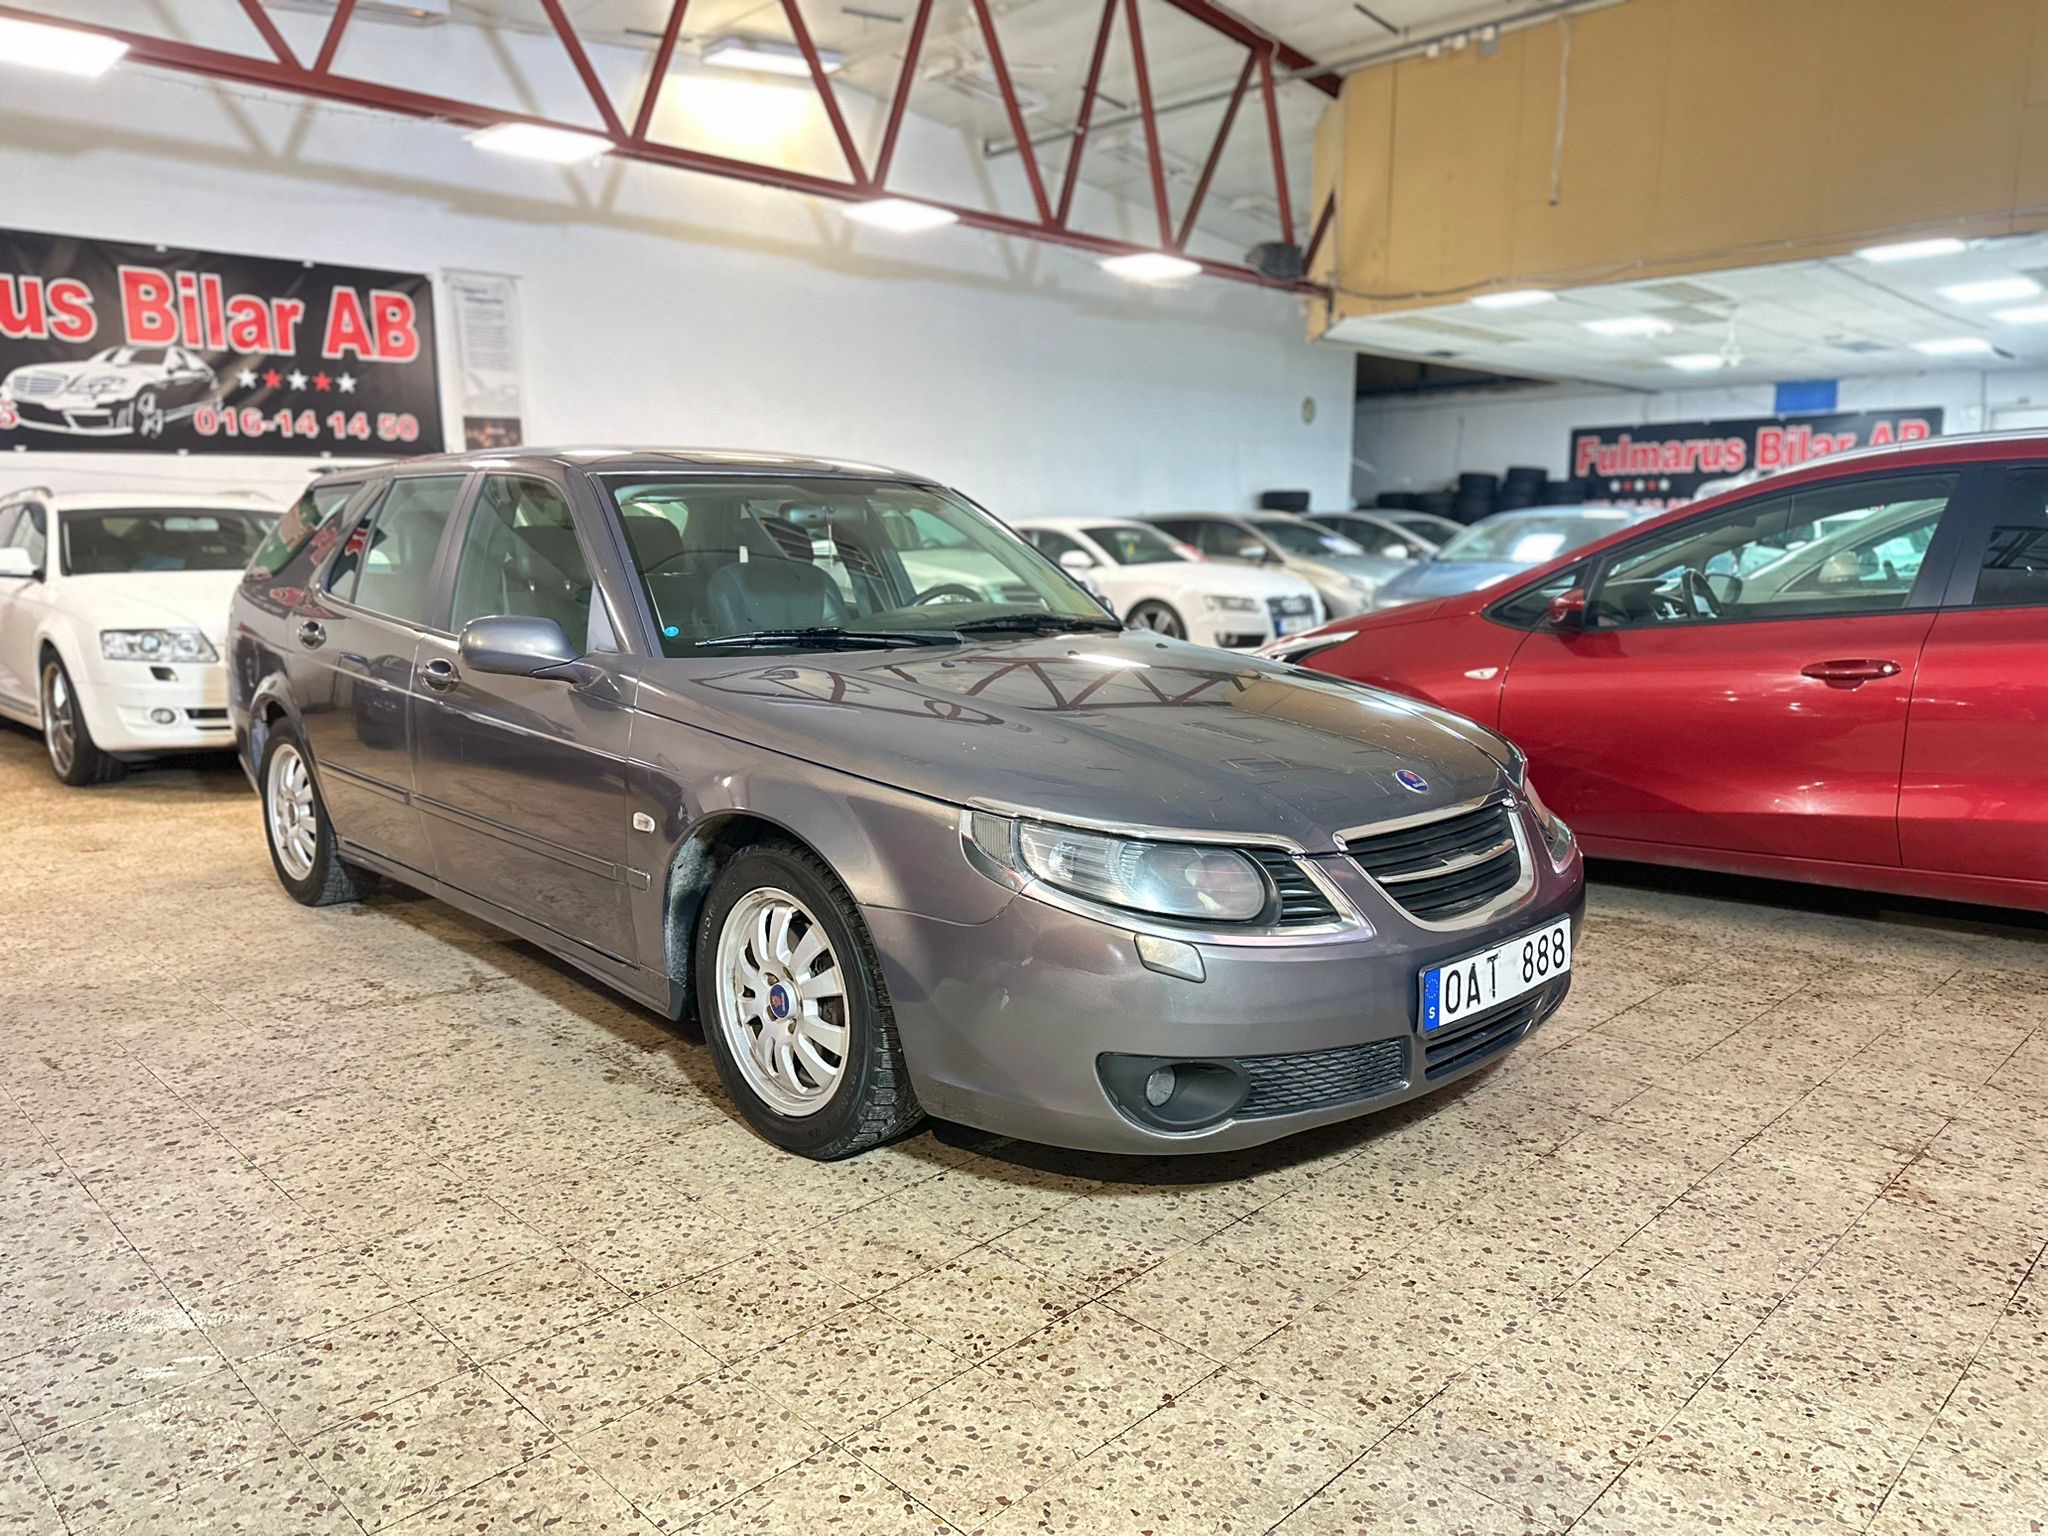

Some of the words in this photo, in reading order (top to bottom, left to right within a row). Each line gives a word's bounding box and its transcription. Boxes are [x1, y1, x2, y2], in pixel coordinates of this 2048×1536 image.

[119, 266, 304, 355] Bilar
[322, 286, 420, 363] AB
[193, 406, 320, 439] 016-14
[326, 410, 371, 440] 14
[376, 412, 420, 443] 50
[1575, 433, 1747, 477] Fulmarus
[1756, 424, 1858, 467] Bilar
[1446, 955, 1499, 1013] OAT
[1523, 928, 1565, 983] 888
[1428, 1007, 1436, 1020] S
